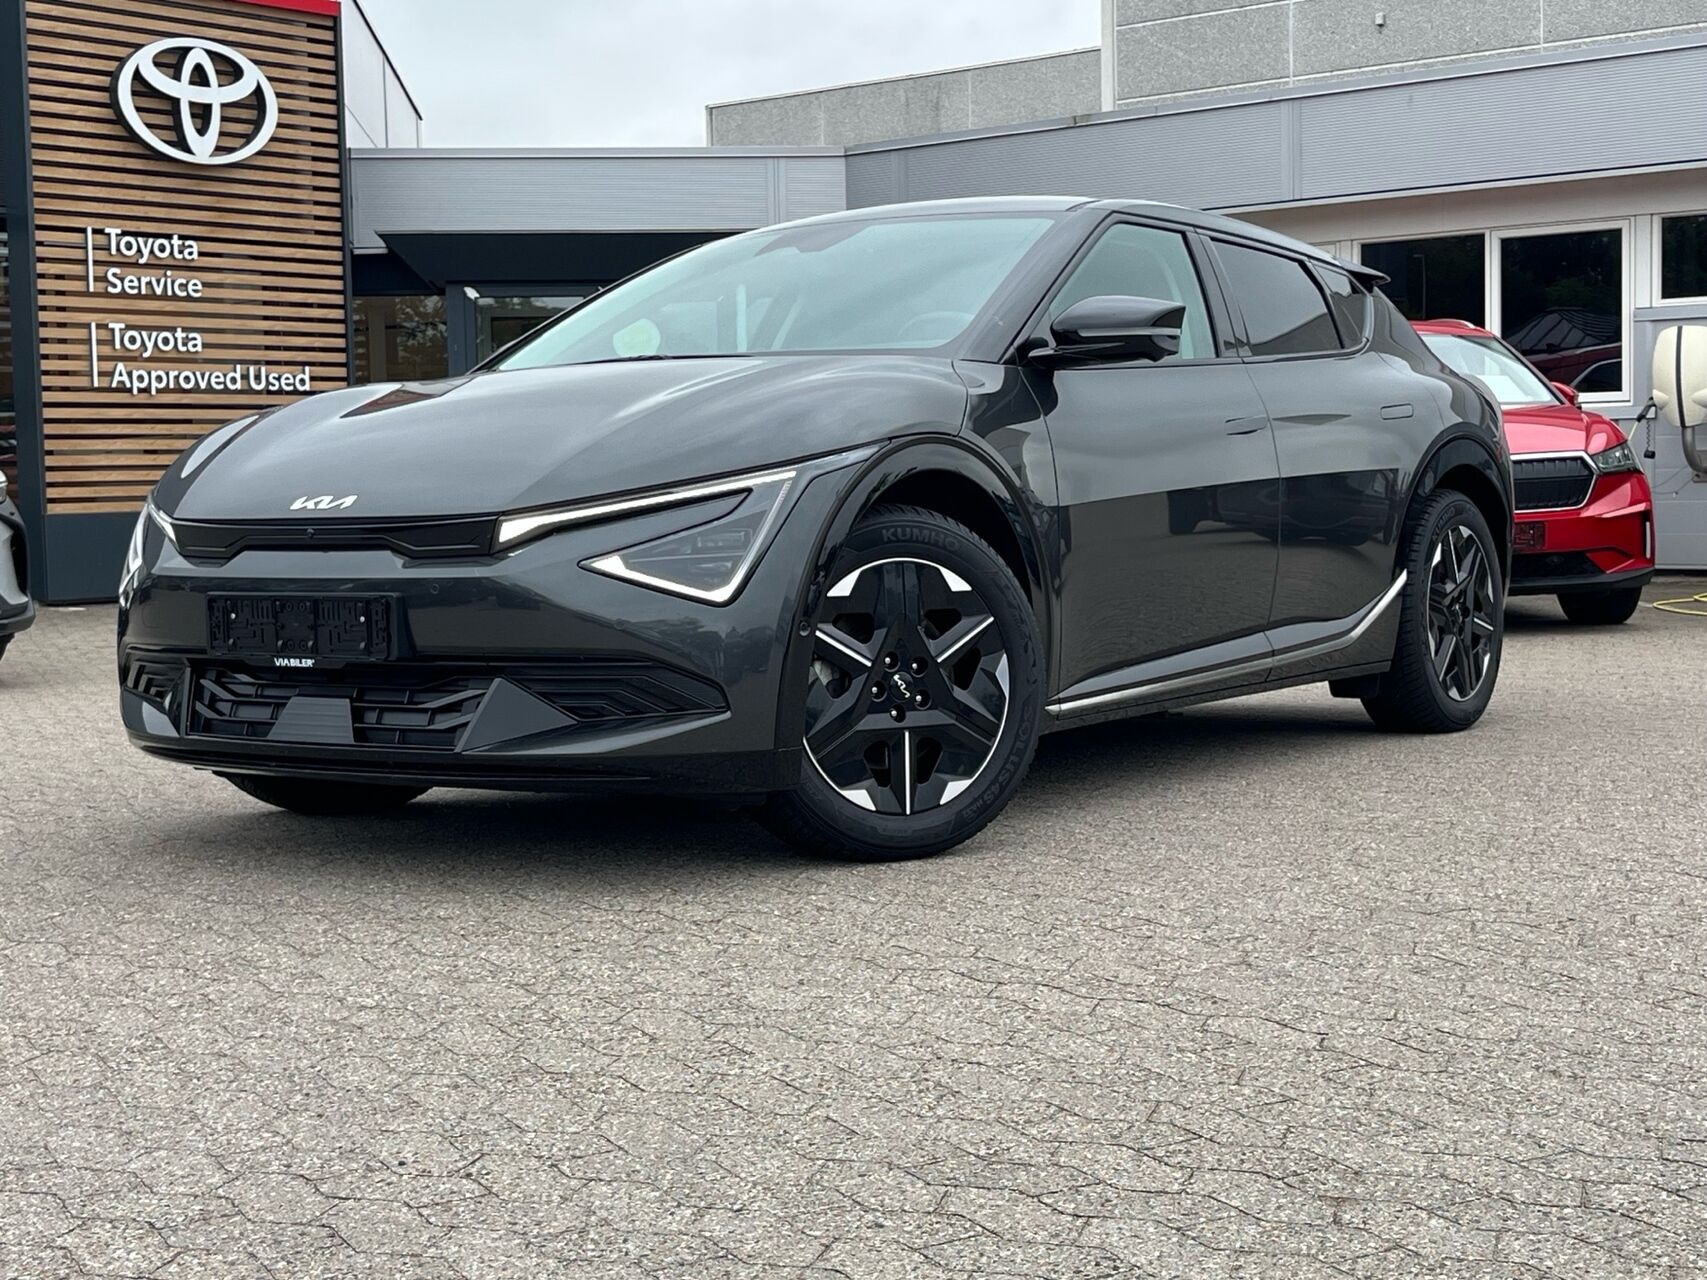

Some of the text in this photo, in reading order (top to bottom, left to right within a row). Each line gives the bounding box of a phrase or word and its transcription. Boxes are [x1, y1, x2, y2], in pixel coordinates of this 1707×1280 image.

[104, 228, 199, 263] Toyota
[105, 268, 203, 297] Service
[107, 323, 203, 357] Toyota
[111, 363, 311, 395] Approved Used
[289, 495, 358, 510] KIA
[881, 527, 960, 551] KUMHO
